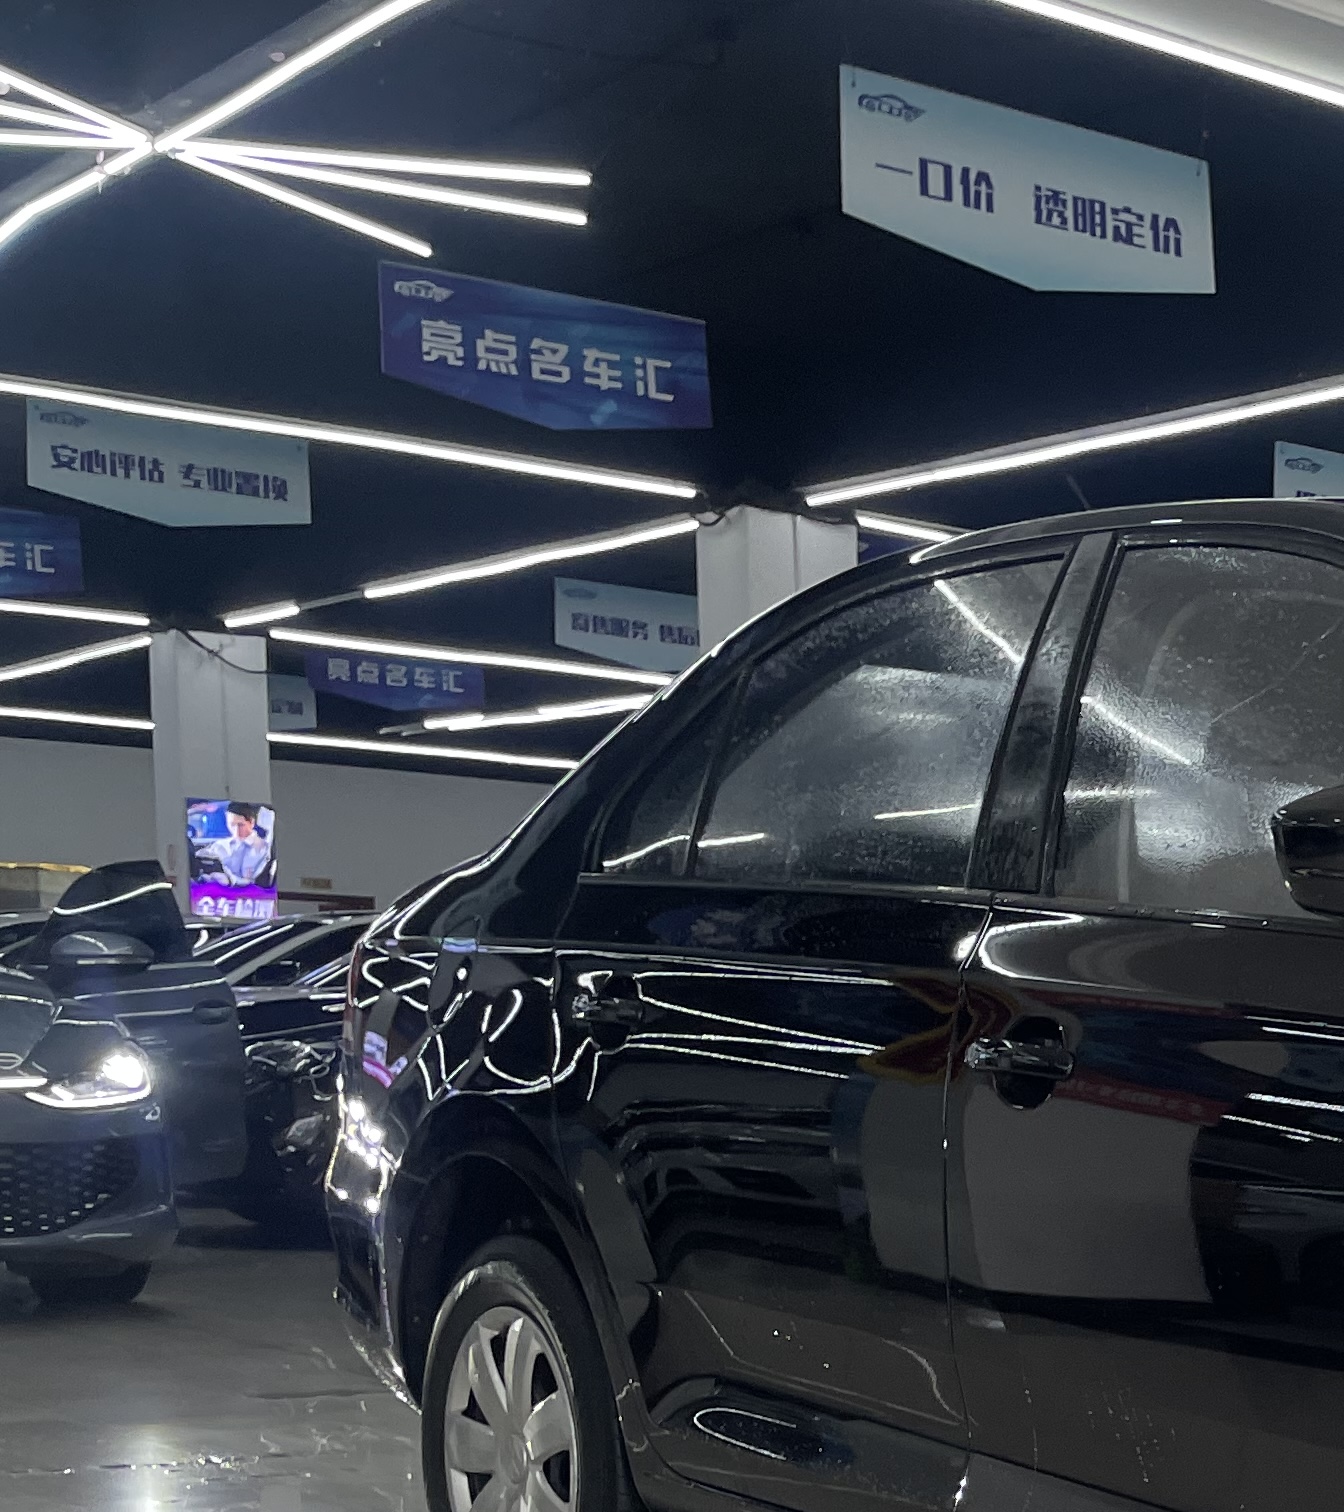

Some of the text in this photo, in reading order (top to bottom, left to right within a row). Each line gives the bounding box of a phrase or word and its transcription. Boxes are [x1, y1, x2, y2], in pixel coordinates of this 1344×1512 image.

[875, 157, 1183, 258] 一口价 透明定价
[421, 319, 675, 402] 亮点名车汇
[50, 444, 165, 484] 安心评估
[327, 657, 466, 693] 亮点名车汇
